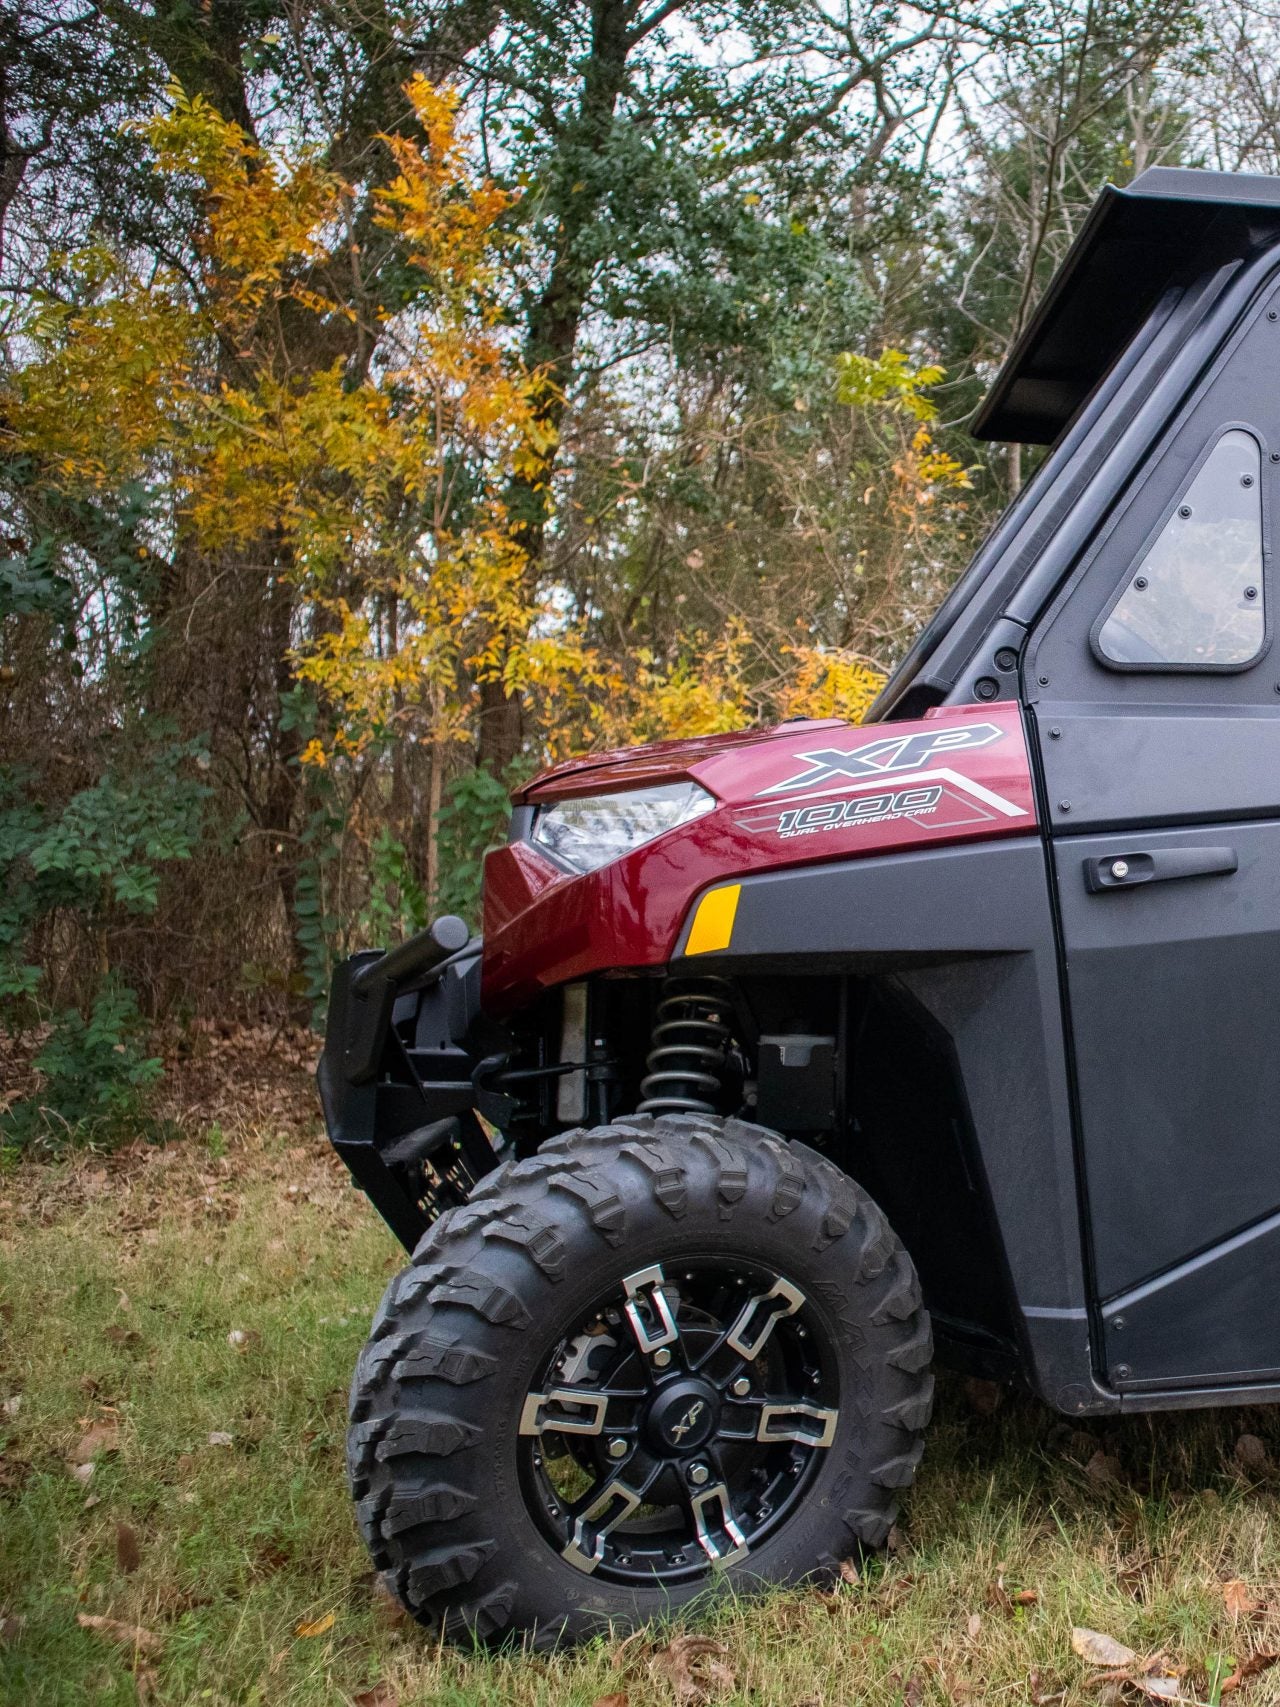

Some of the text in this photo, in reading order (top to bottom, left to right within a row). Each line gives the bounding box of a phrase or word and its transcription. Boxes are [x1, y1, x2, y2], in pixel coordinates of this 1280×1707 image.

[754, 722, 1004, 796] XP
[777, 785, 944, 832] 1000
[779, 806, 937, 839] DUAL OVERHEAD CAM
[671, 1400, 704, 1444] XP
